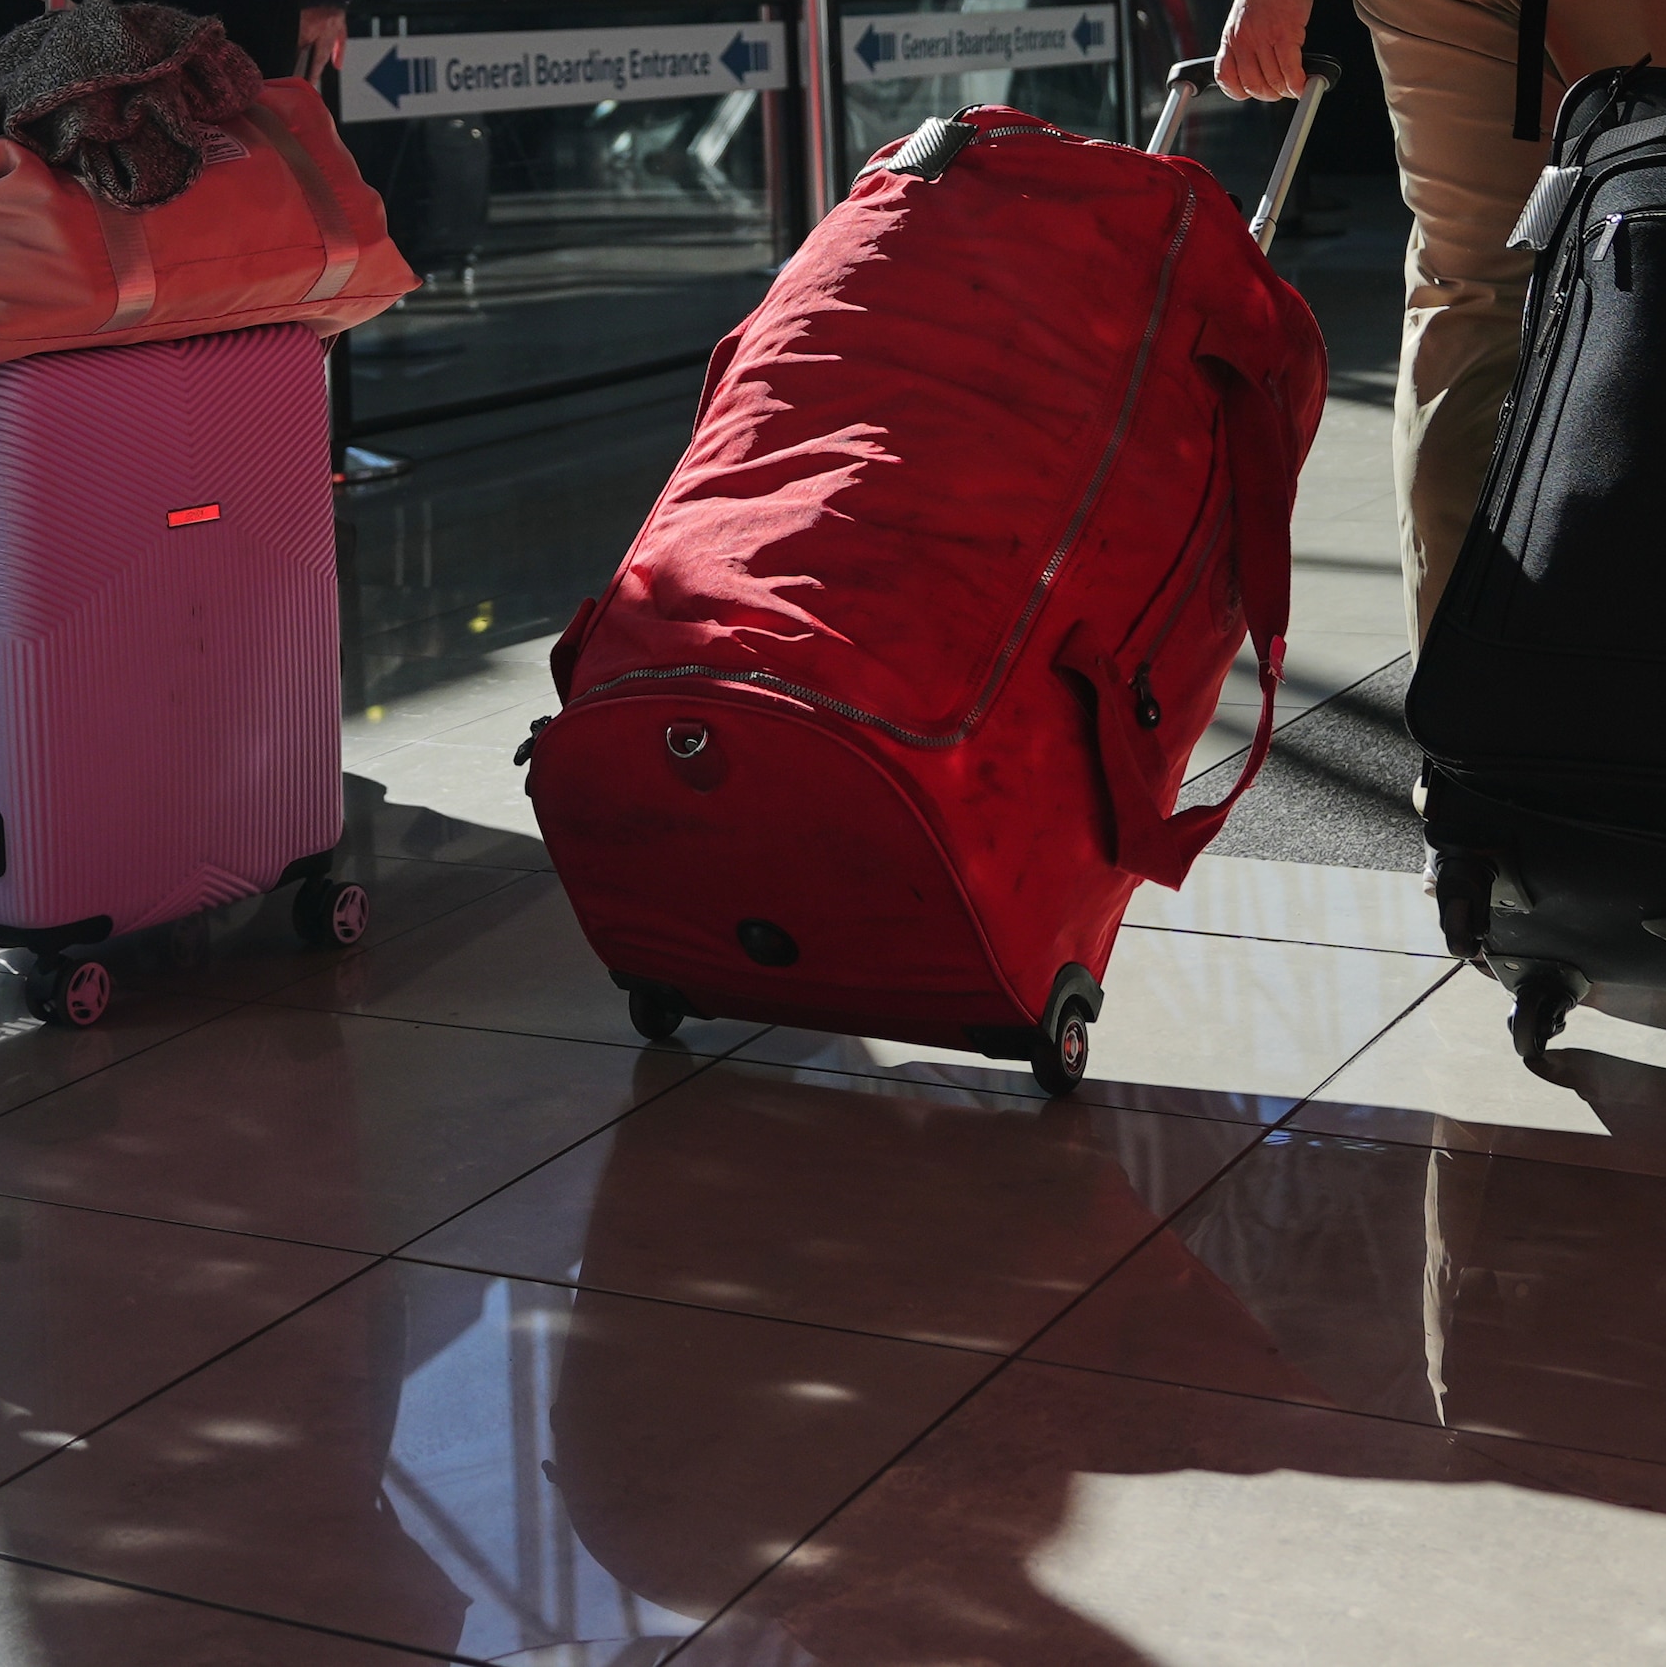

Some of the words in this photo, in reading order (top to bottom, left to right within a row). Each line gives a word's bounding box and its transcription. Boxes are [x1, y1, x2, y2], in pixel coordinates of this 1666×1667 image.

[901, 28, 952, 61] General
[955, 27, 1012, 61] Boarding
[1014, 25, 1066, 52] Entrance
[445, 53, 531, 92] General
[535, 49, 626, 90] Boarding
[629, 47, 711, 80] Entrance
